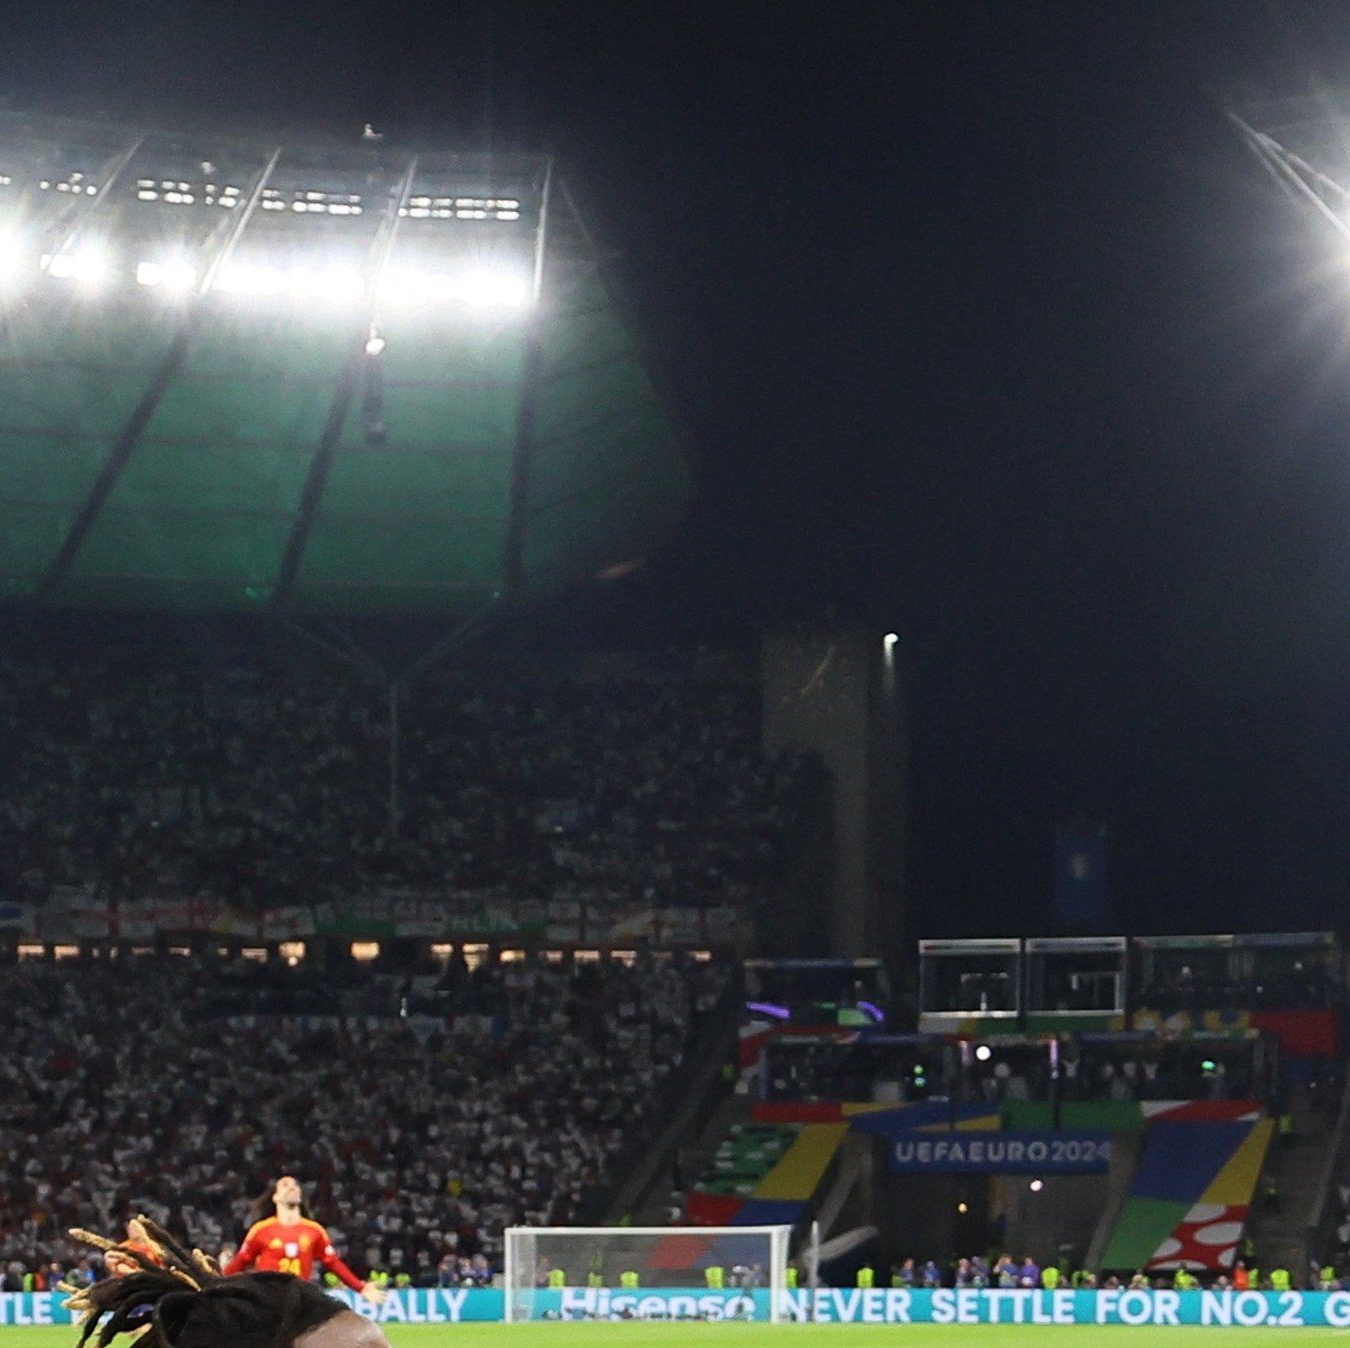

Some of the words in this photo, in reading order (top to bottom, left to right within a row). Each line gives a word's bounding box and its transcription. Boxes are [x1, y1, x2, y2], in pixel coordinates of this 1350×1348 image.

[561, 1287, 756, 1321] Hisense
[782, 1288, 911, 1322] NEVER
[930, 1289, 1076, 1323] SETTLE
[1095, 1289, 1181, 1325] FOR
[1202, 1290, 1304, 1326] NO.2
